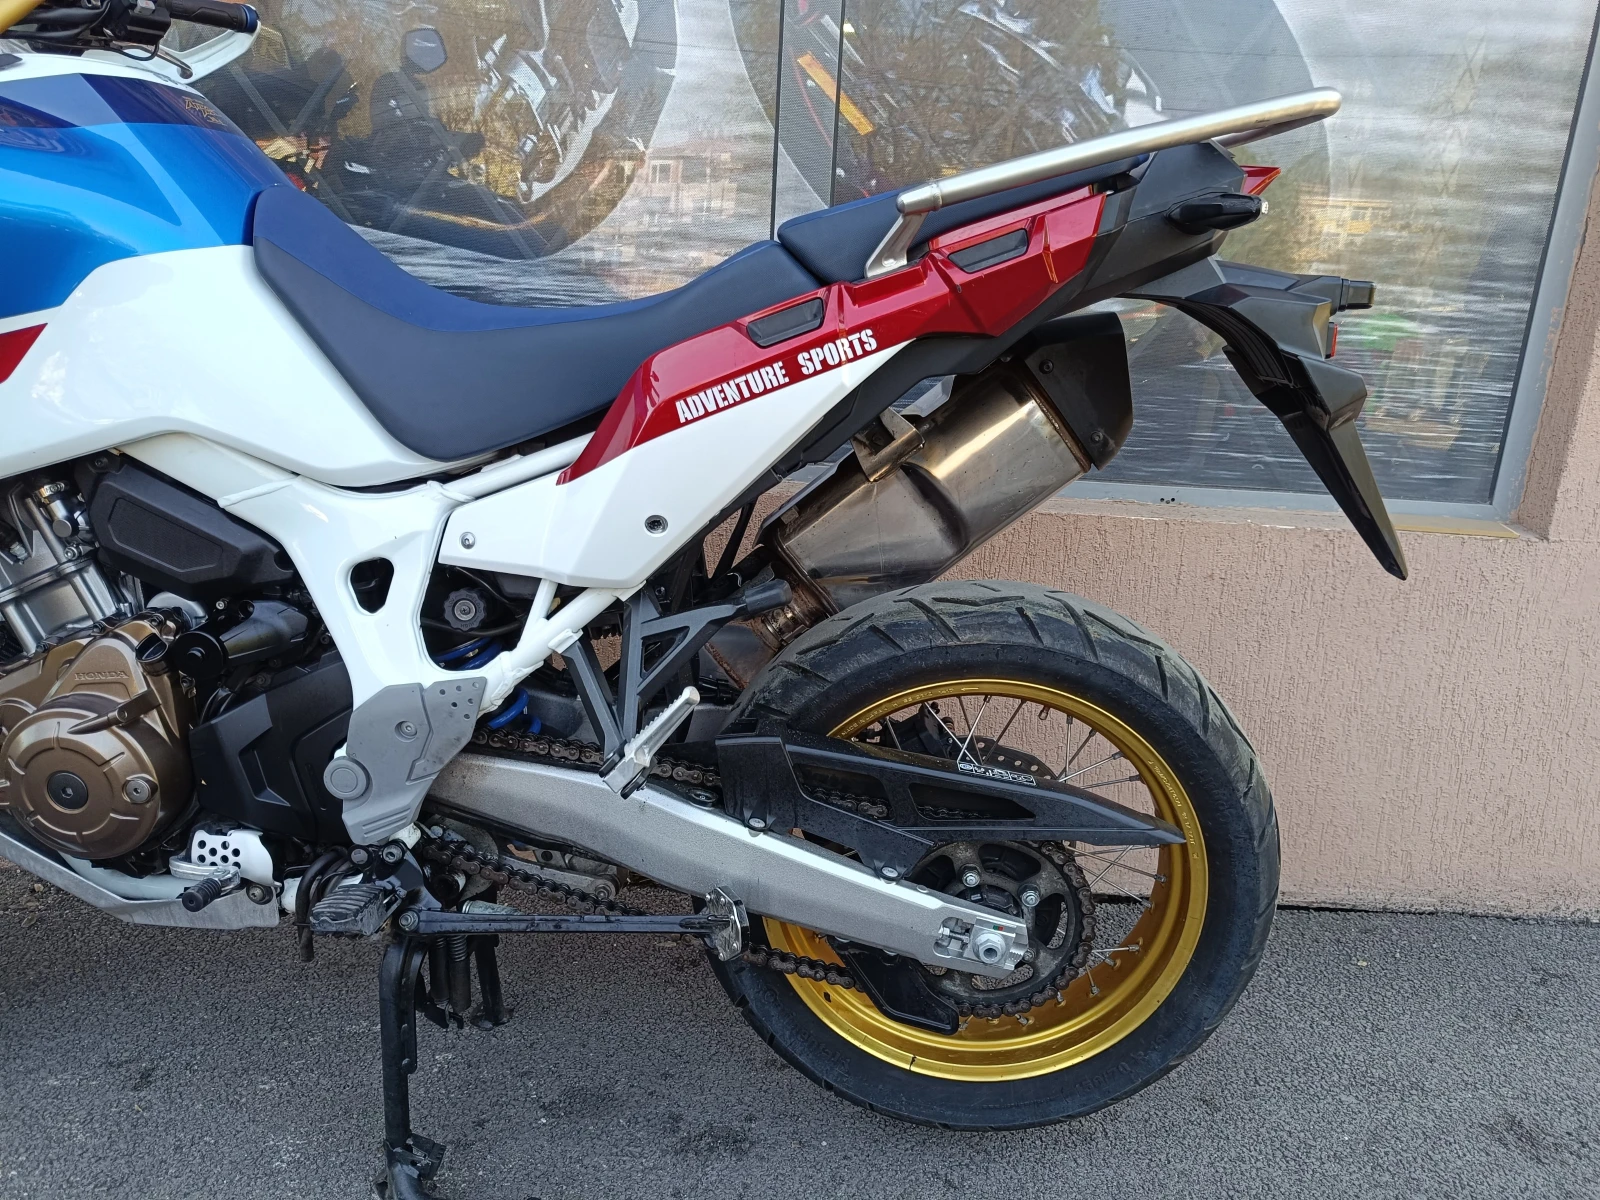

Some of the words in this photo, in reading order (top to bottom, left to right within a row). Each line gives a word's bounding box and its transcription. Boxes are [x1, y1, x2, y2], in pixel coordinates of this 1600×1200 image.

[675, 361, 790, 424] ADVENTURE
[797, 328, 878, 375] SPORTS
[74, 670, 129, 681] HONDA
